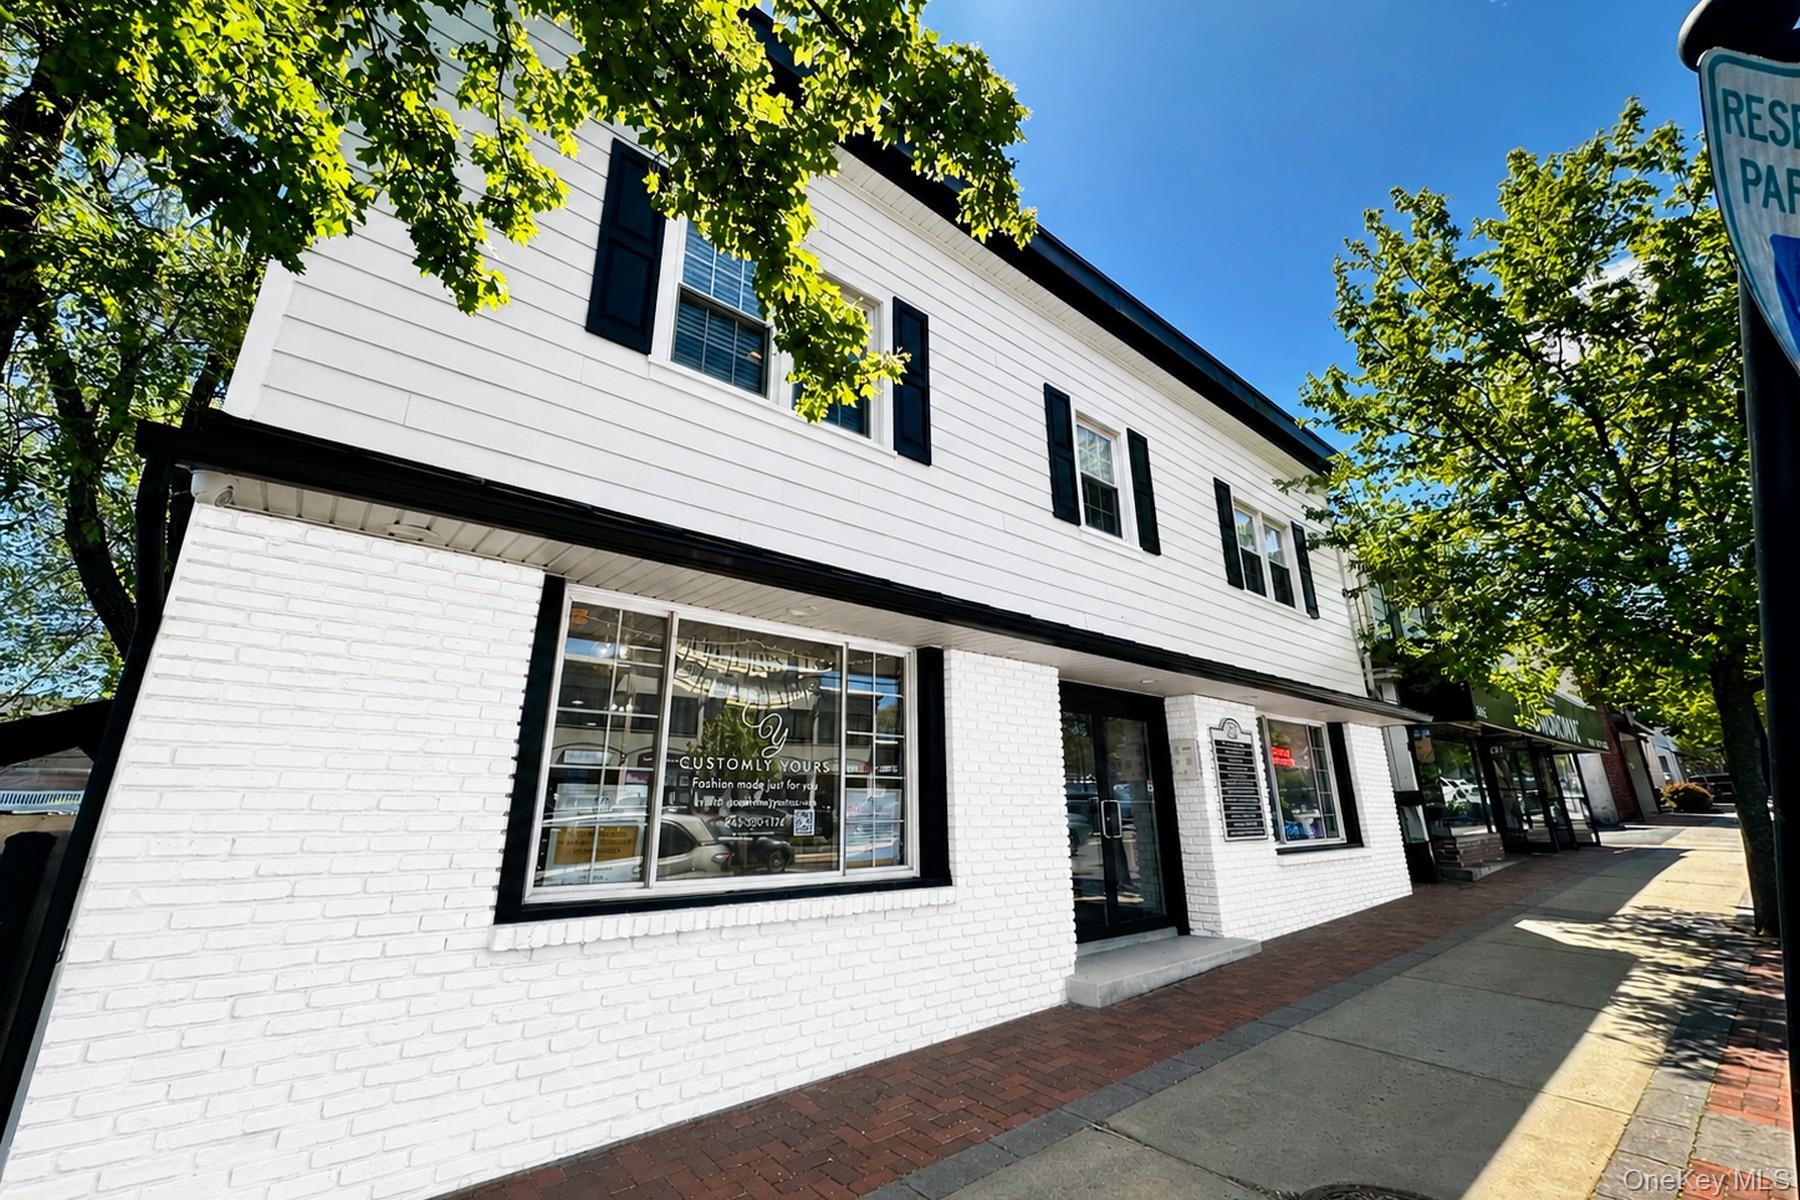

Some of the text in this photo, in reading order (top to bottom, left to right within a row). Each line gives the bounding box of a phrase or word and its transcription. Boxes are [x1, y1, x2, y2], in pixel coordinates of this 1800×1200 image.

[679, 756, 831, 774] CUSTOMLY YOURS
[692, 777, 819, 793] Fashion made just for you
